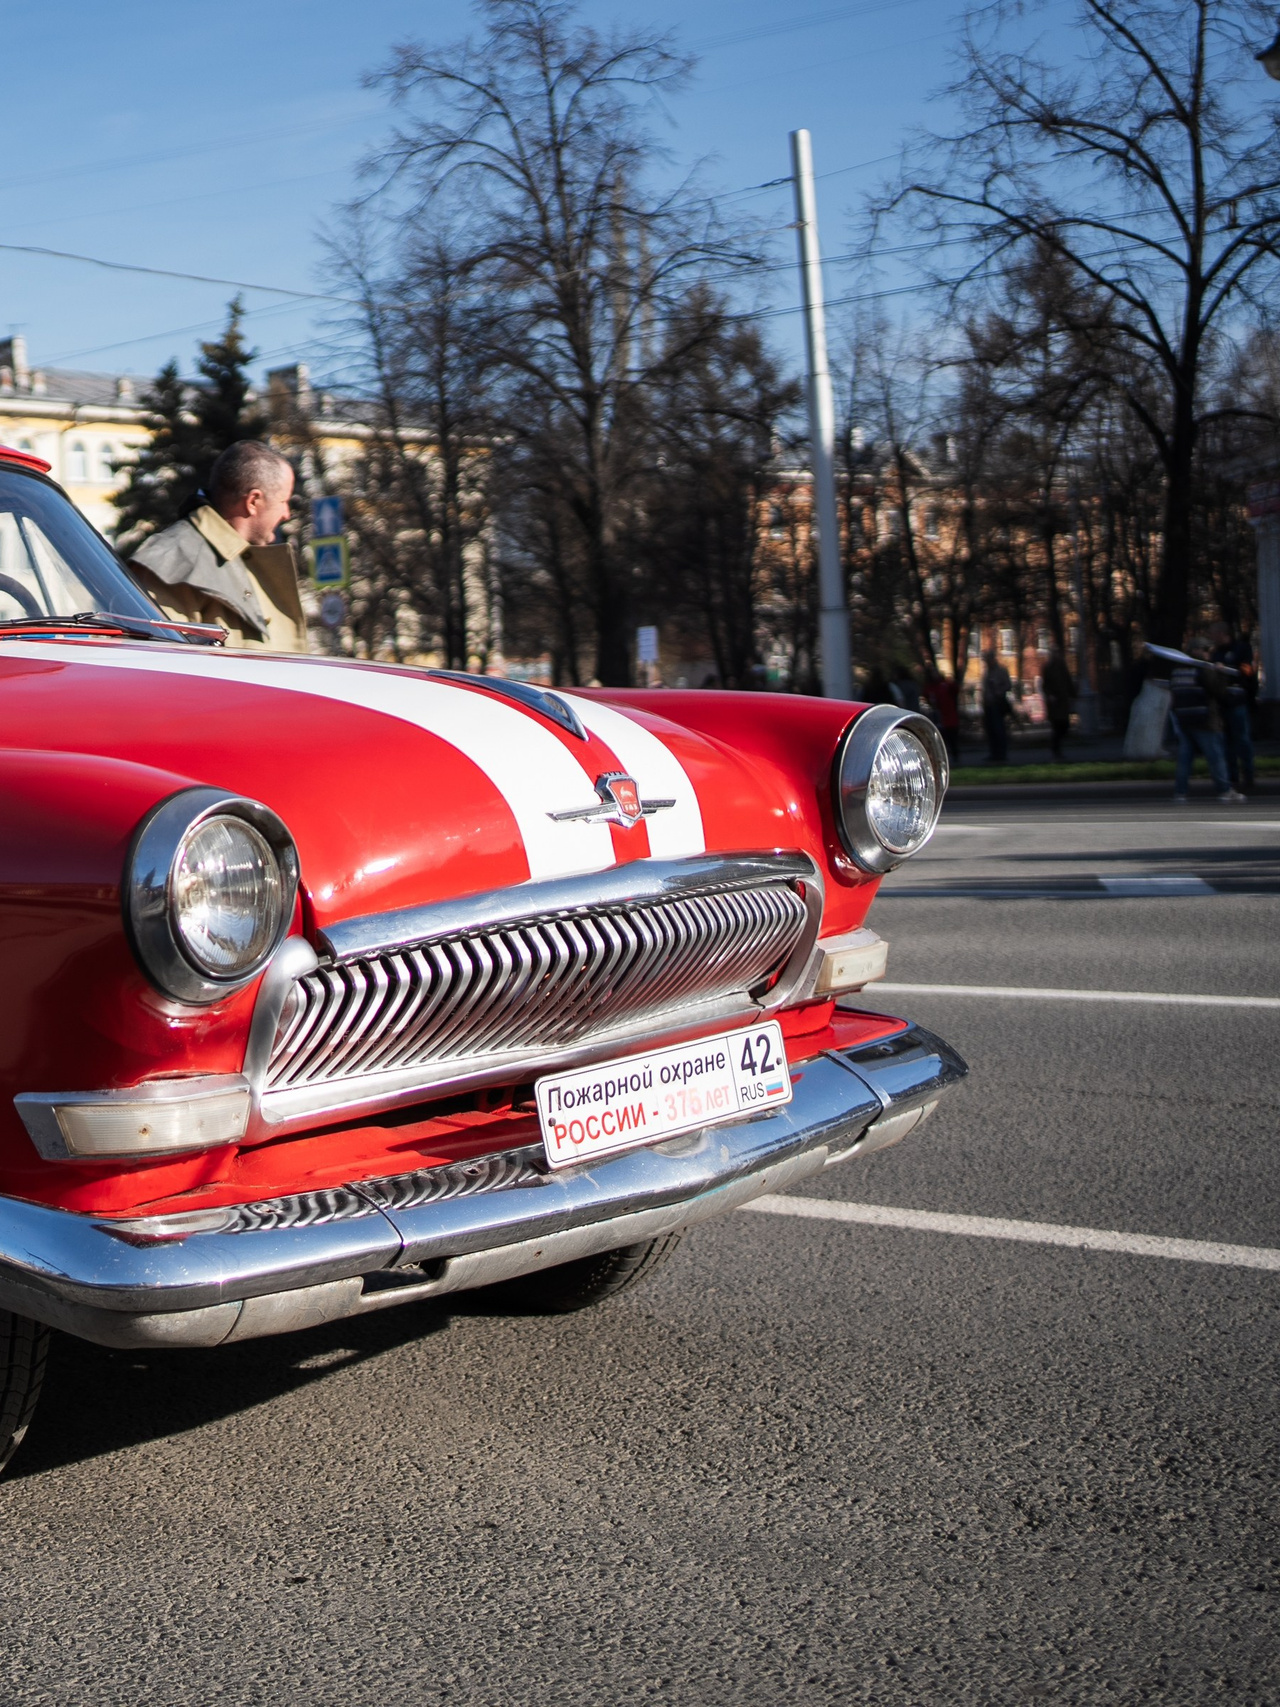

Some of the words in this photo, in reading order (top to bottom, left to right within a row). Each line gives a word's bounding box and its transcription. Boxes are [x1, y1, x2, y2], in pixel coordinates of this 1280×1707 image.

[548, 1064, 653, 1113] Пожарной
[659, 1050, 726, 1085] охране
[740, 1033, 775, 1077] 42
[554, 1101, 646, 1149] РОССИИ
[705, 1085, 730, 1112] лет
[740, 1082, 765, 1103] RUS
